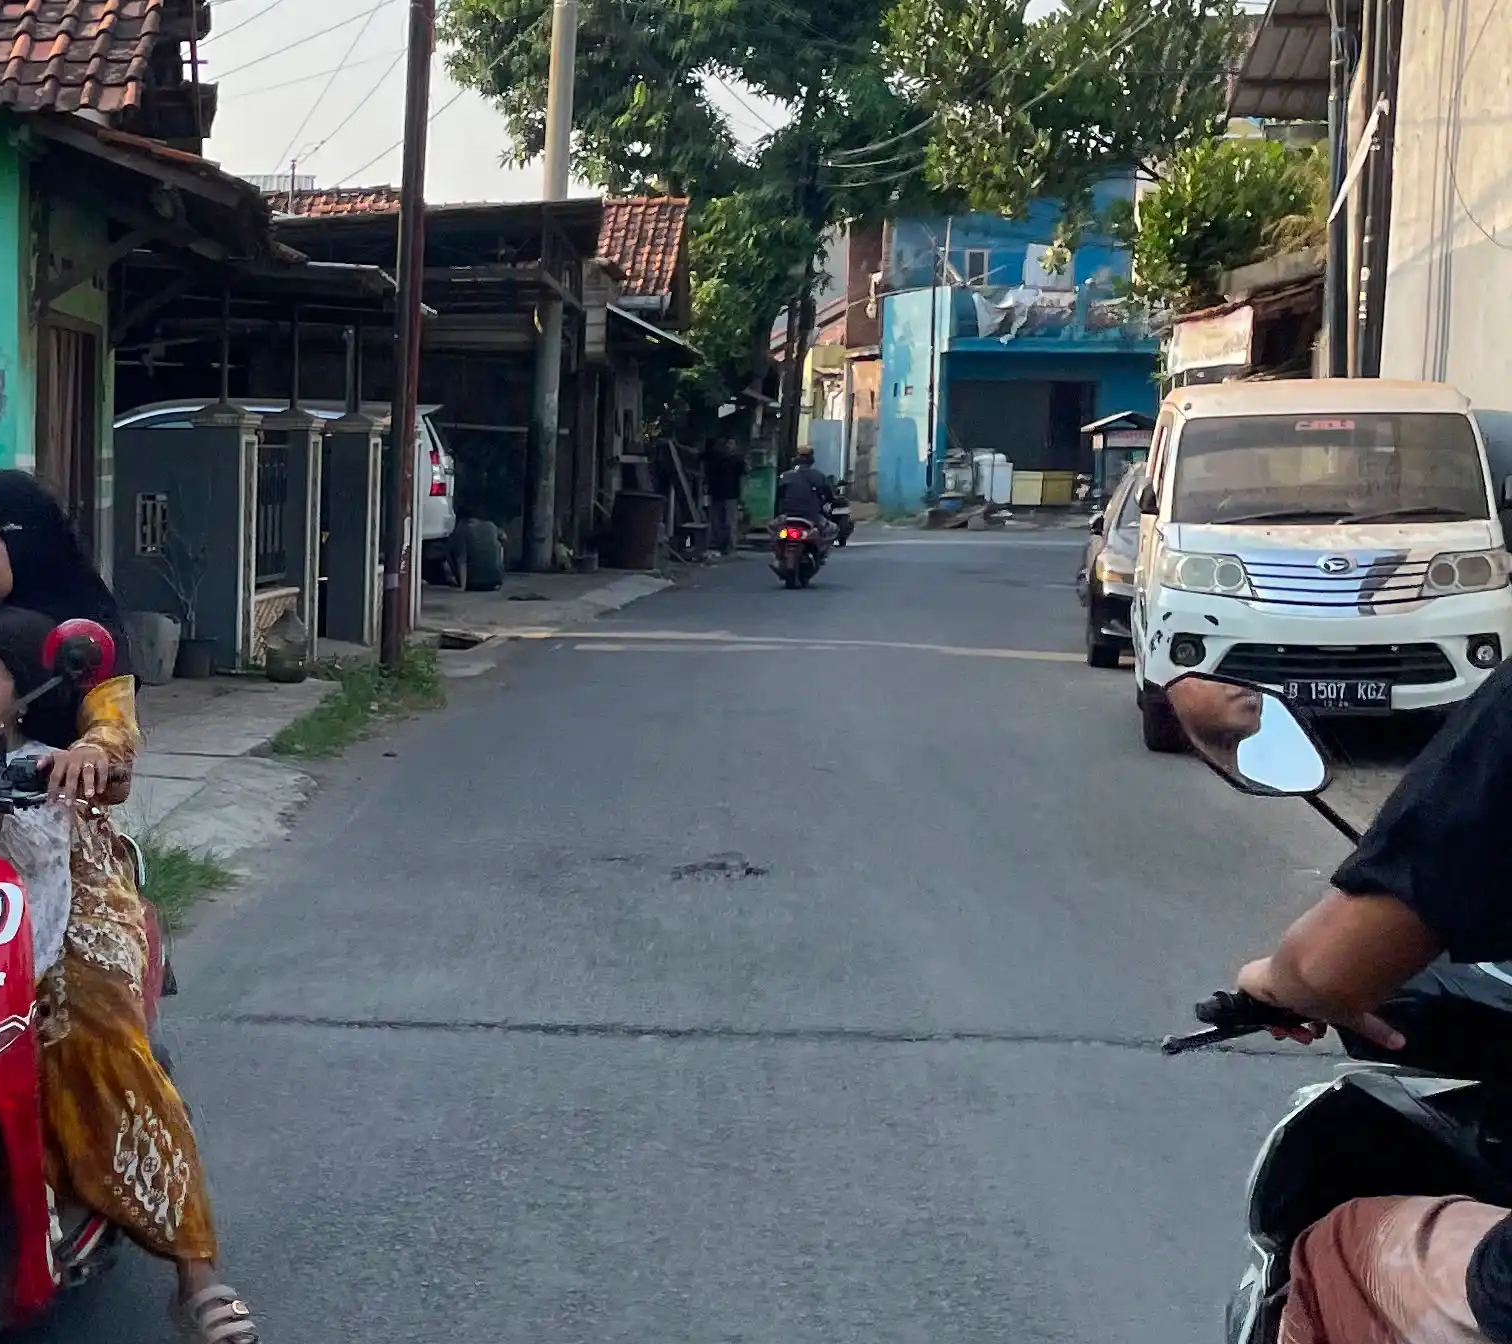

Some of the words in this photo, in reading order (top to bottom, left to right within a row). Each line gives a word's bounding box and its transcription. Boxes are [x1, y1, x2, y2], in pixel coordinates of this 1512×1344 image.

[1288, 682, 1299, 699] B
[1310, 682, 1347, 700] 1507
[1357, 681, 1387, 700] KGZ
